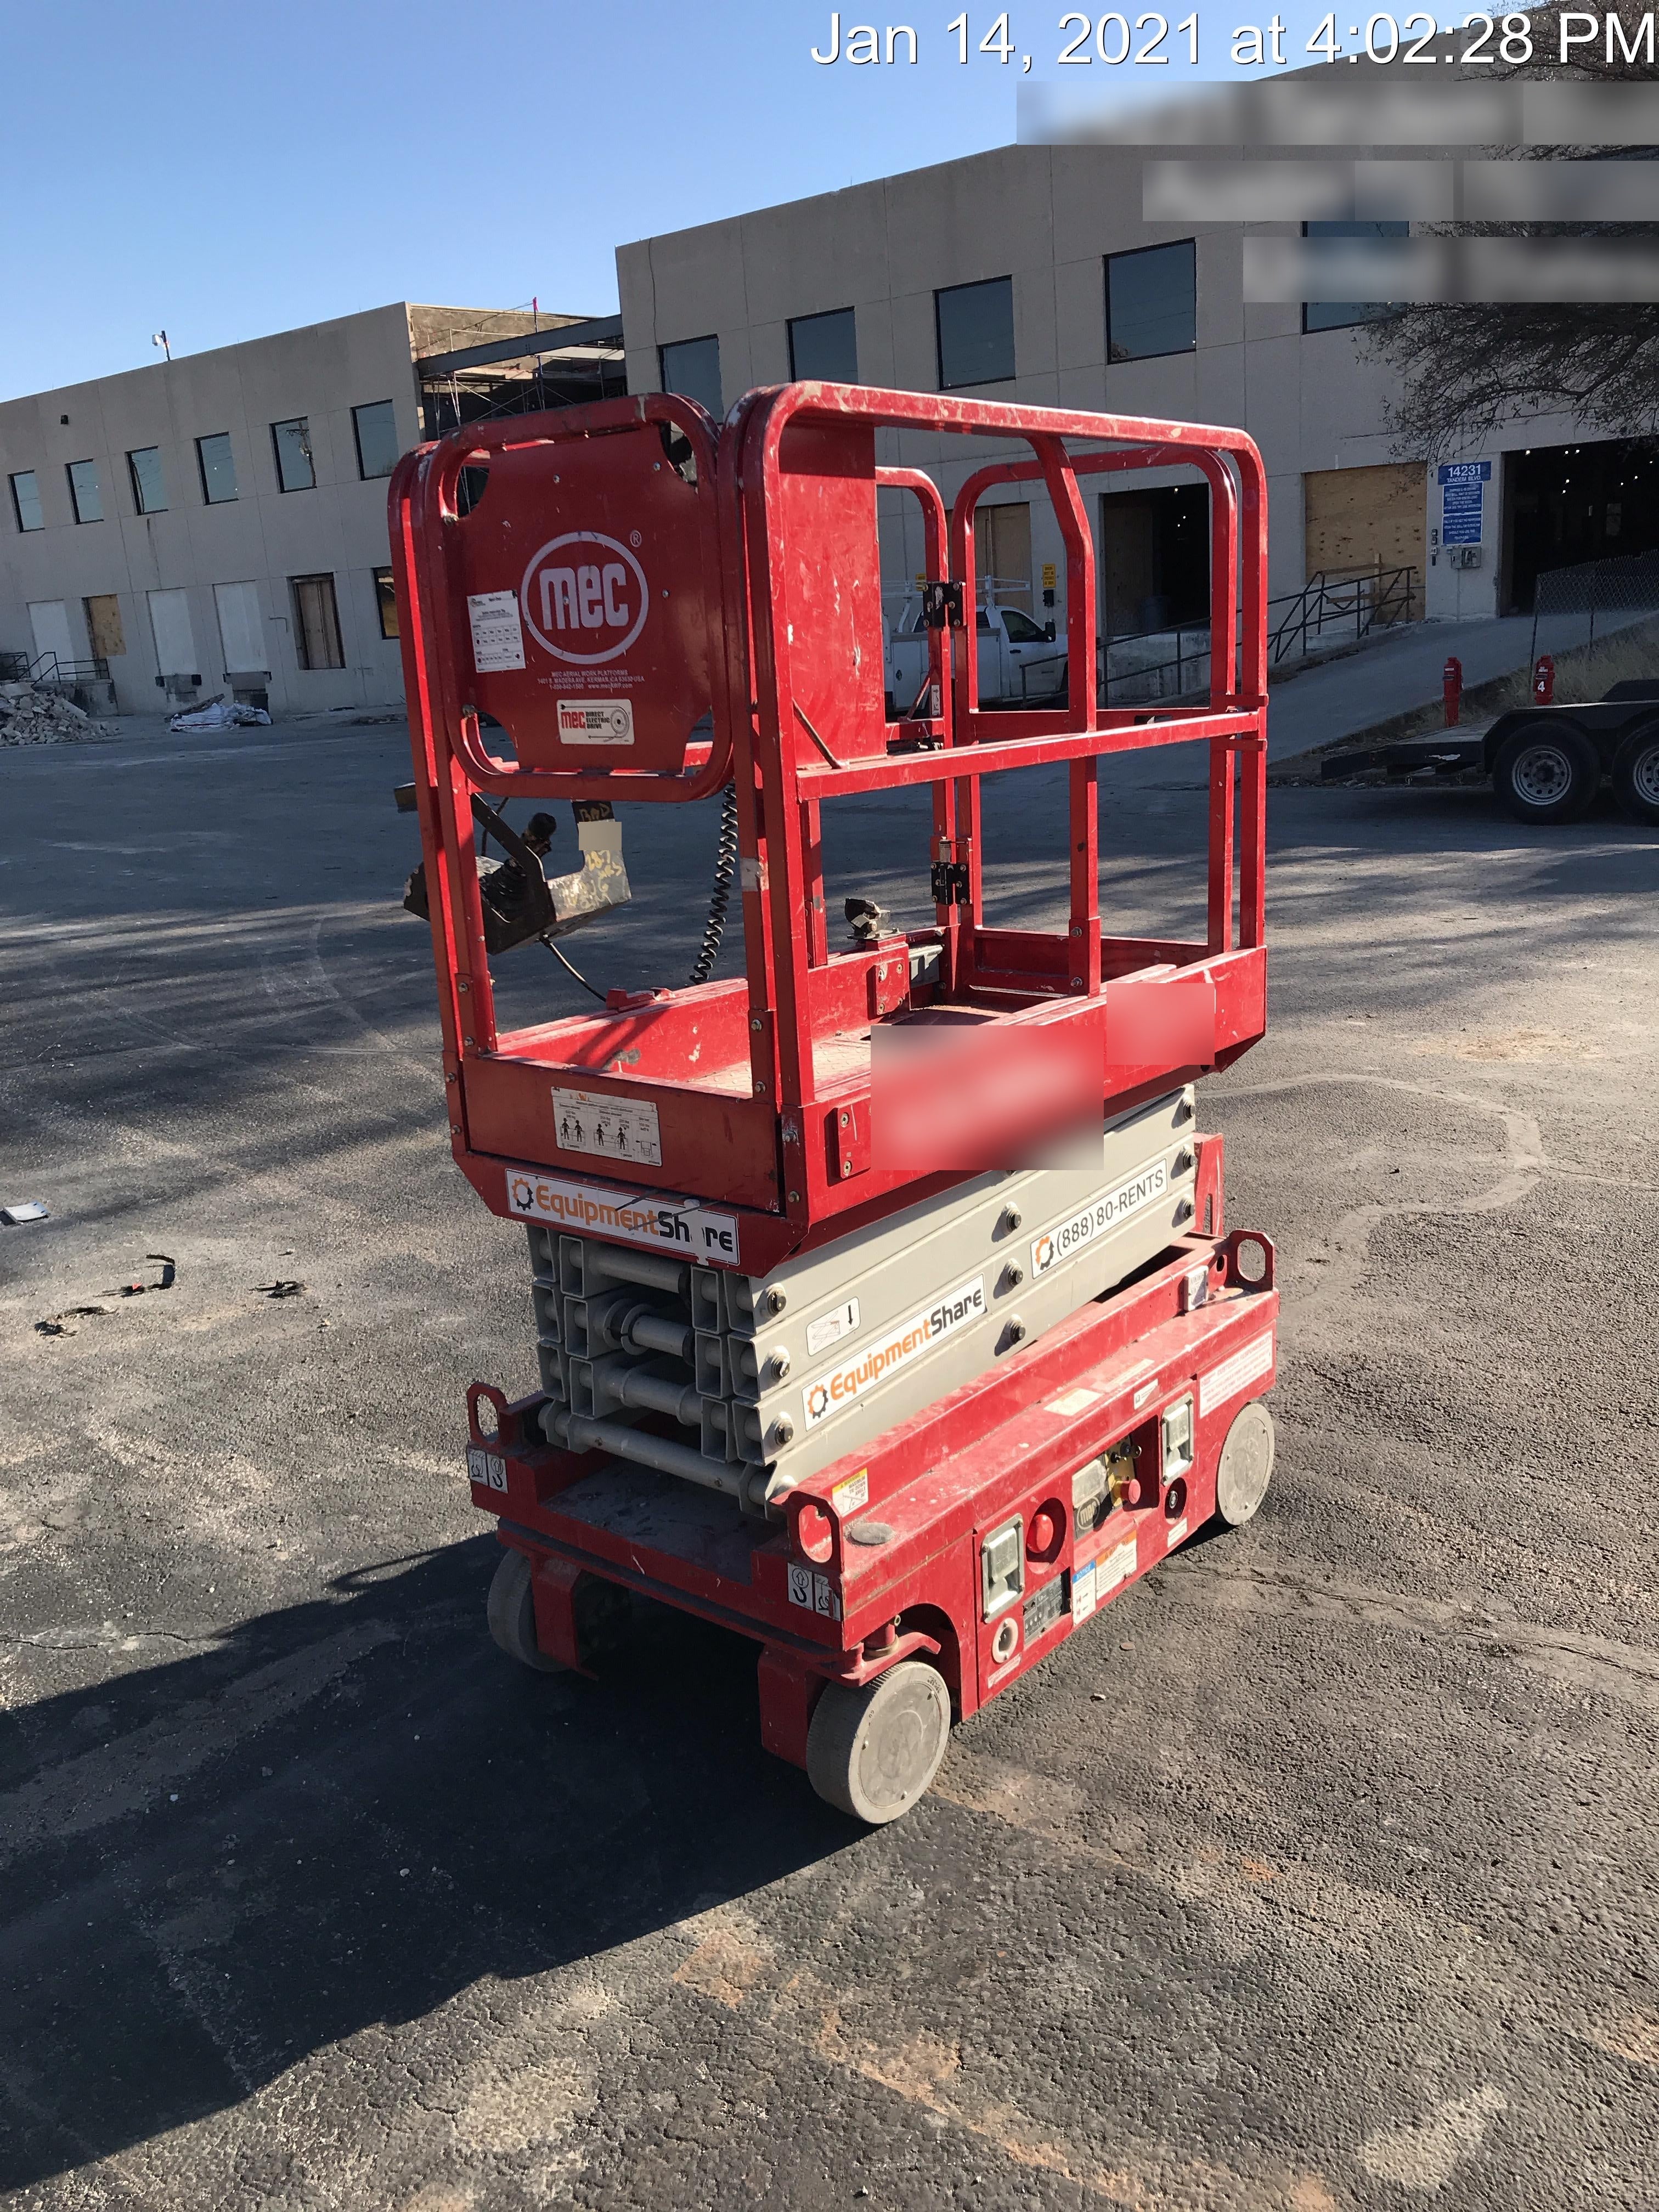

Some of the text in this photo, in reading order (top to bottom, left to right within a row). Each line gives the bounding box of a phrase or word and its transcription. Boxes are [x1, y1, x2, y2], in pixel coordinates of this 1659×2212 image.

[1448, 464, 1481, 477] 14231
[1537, 681, 1545, 692] 4
[535, 1184, 733, 1252] EquipmentShre
[1057, 1169, 1164, 1256] (888) 80-RENTS
[830, 1288, 983, 1401] EquipmentShare
[848, 1475, 866, 1489] MAXIMUM
